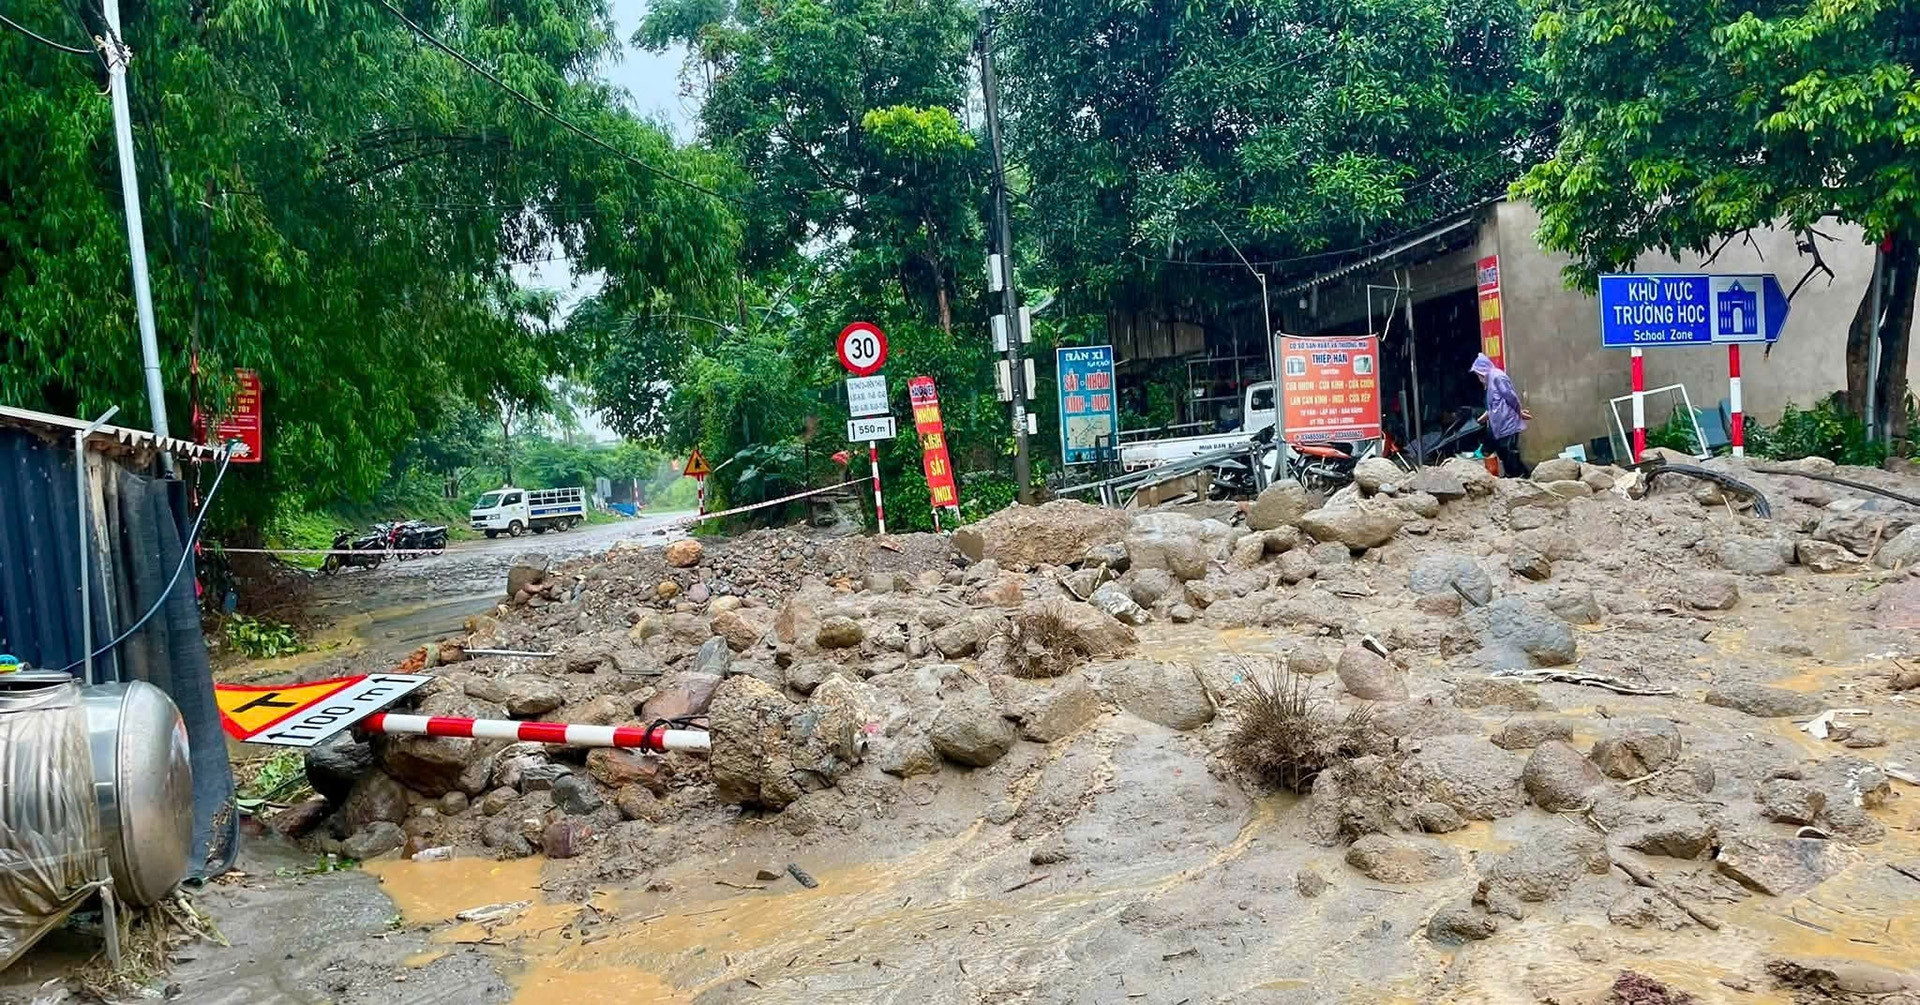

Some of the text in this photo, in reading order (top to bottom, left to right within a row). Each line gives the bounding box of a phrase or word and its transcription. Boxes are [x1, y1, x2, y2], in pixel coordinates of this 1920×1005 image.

[1628, 280, 1694, 303] KHU VỰC
[1613, 302, 1706, 327] TRƯỜNG HỌC
[1634, 329, 1694, 341] School Zone
[851, 337, 875, 360] 30
[1063, 368, 1111, 392] SẮT NHÔM
[858, 424, 886, 435] 550 m
[929, 453, 946, 477] SẮT
[933, 485, 954, 503] INOX
[290, 706, 355, 730] 100
